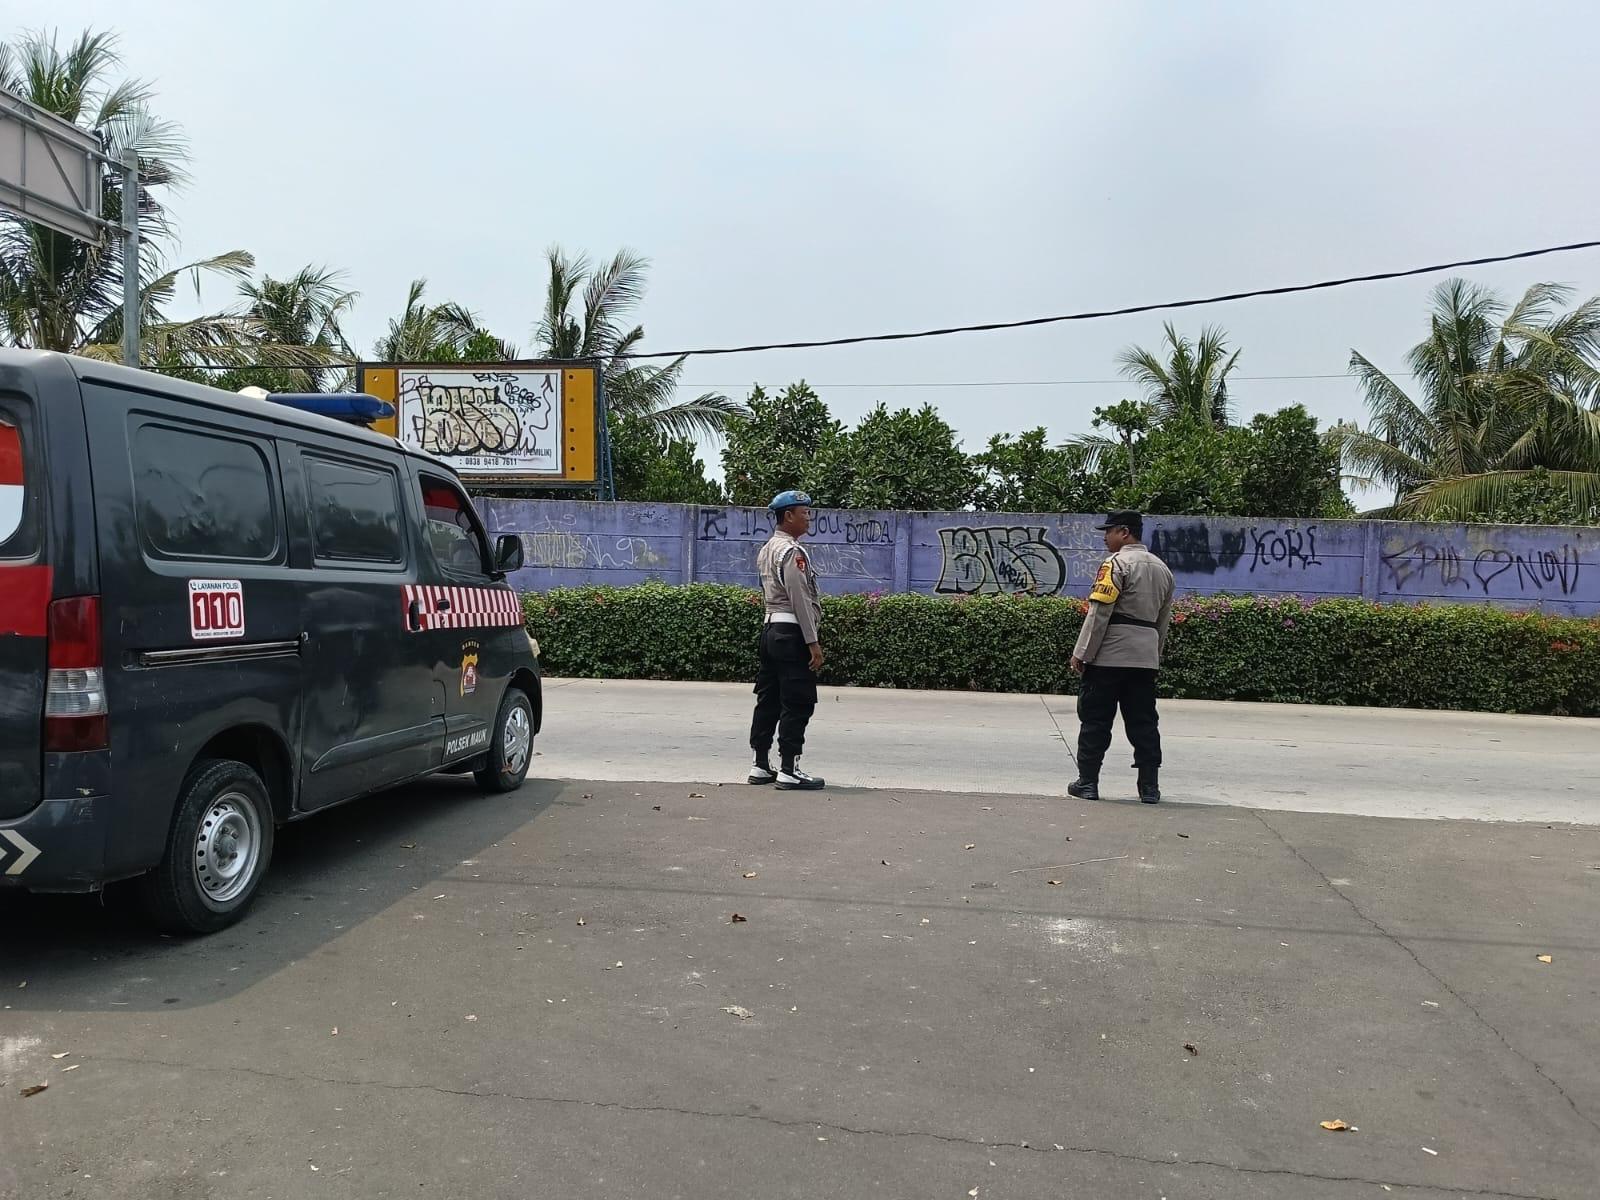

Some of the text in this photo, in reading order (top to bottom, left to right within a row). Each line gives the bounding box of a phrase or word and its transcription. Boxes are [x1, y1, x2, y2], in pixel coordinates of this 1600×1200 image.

[197, 582, 239, 590] LAYANAN POLISI
[195, 595, 240, 628] 110
[446, 734, 471, 756] POLSEK
